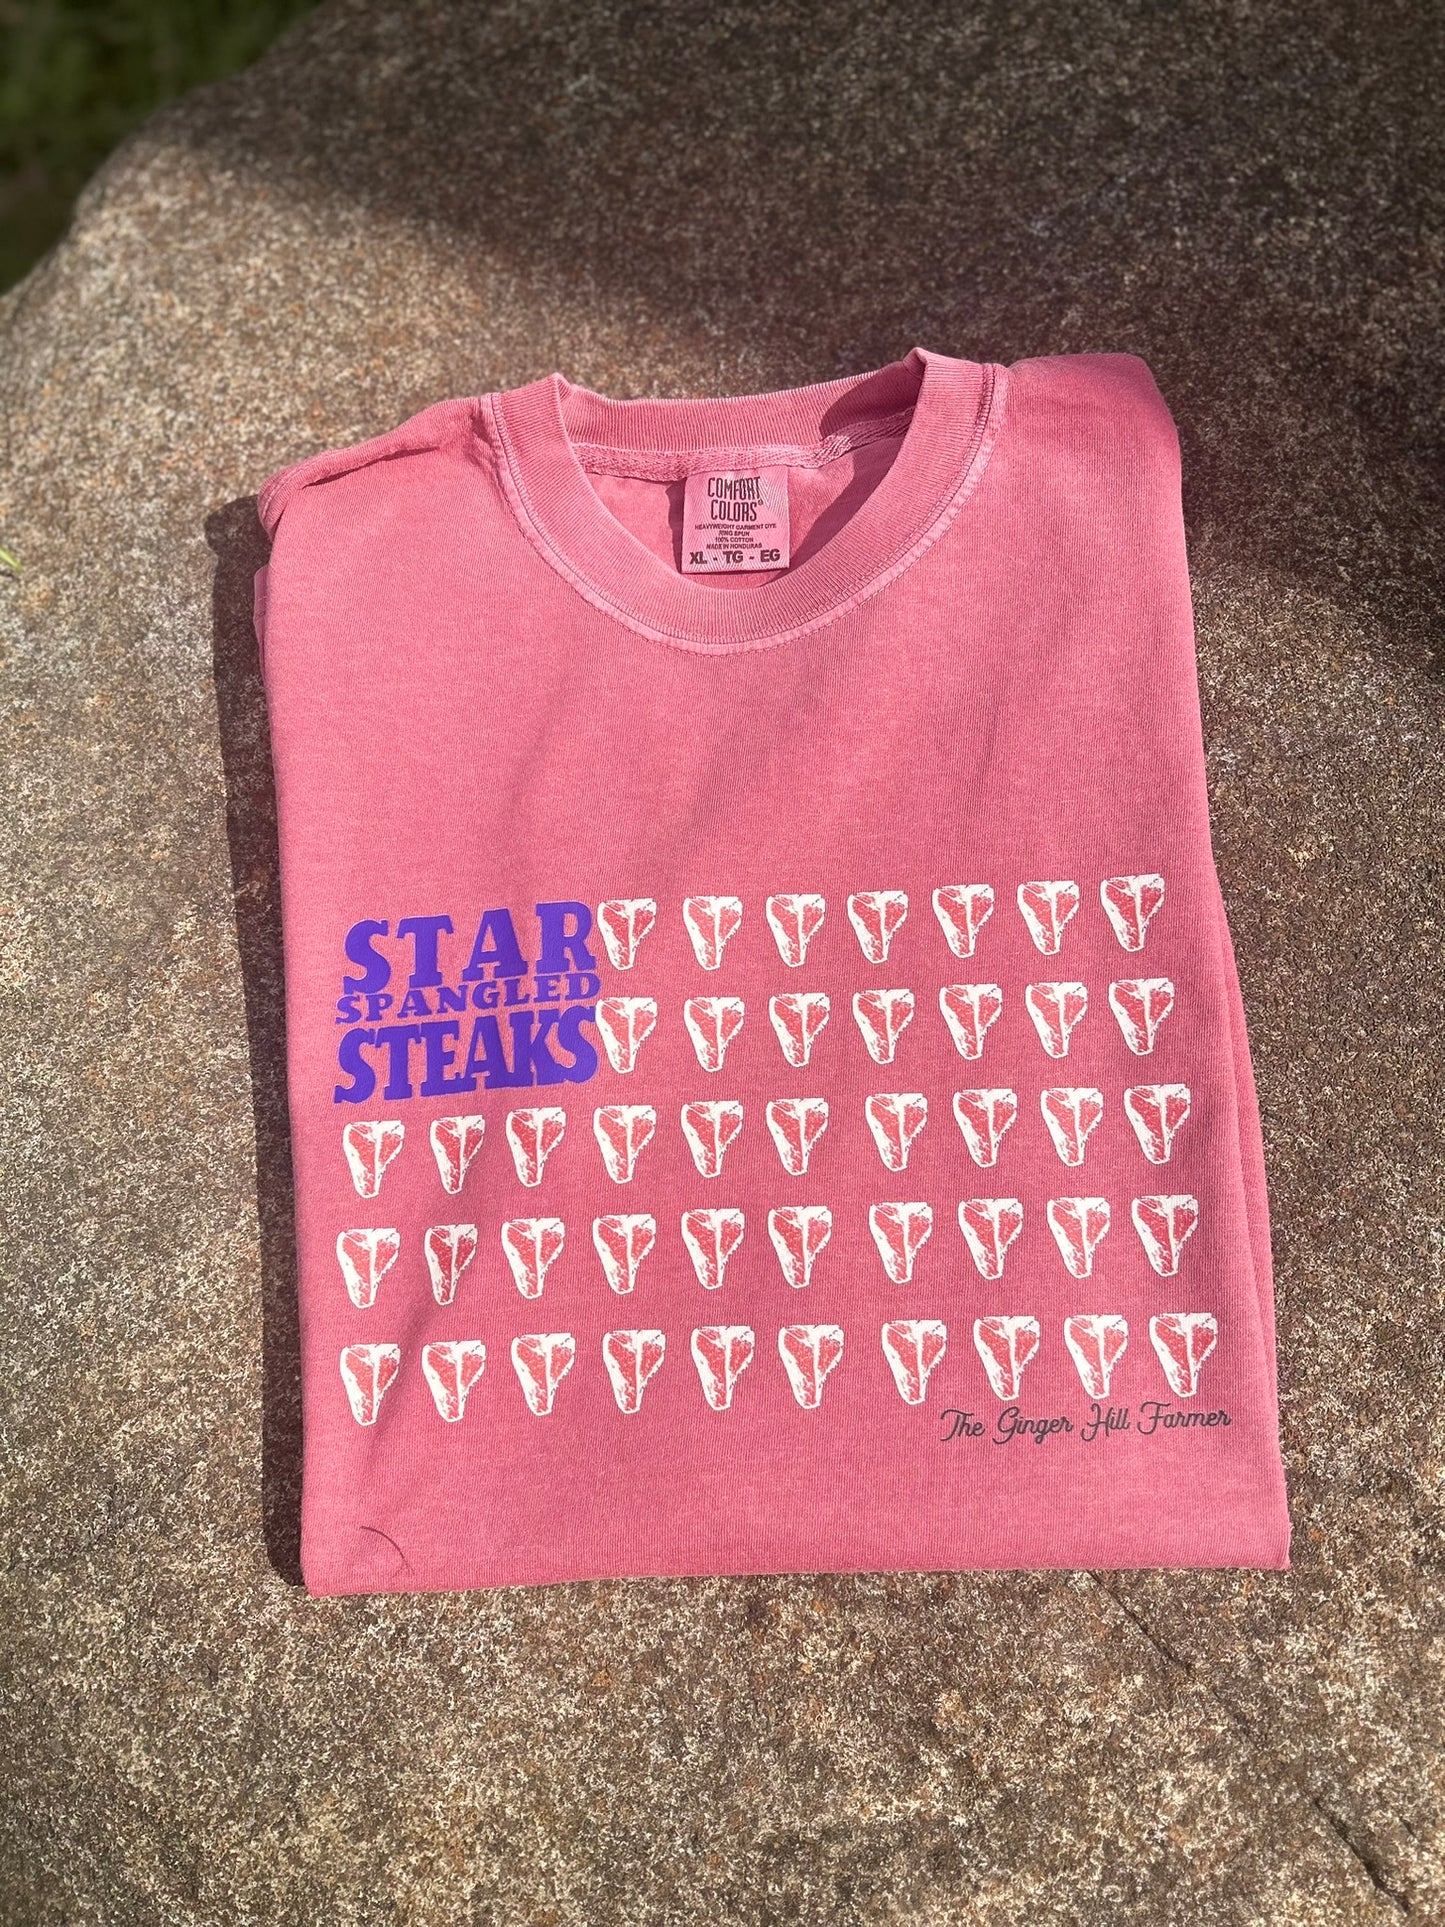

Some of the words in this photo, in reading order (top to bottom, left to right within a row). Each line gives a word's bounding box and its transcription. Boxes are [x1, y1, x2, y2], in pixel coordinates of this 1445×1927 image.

[707, 476, 761, 500] COMFORT
[689, 551, 708, 564] XL
[722, 550, 744, 564] TG
[760, 549, 780, 563] EG
[343, 901, 598, 995] STAR
[335, 972, 601, 1024] SPANGLED
[333, 1005, 598, 1104] STEAKS
[940, 1408, 985, 1442] The
[992, 1406, 1074, 1444] Ginger
[1080, 1403, 1130, 1442] Hill
[1137, 1401, 1232, 1435] Farmer
